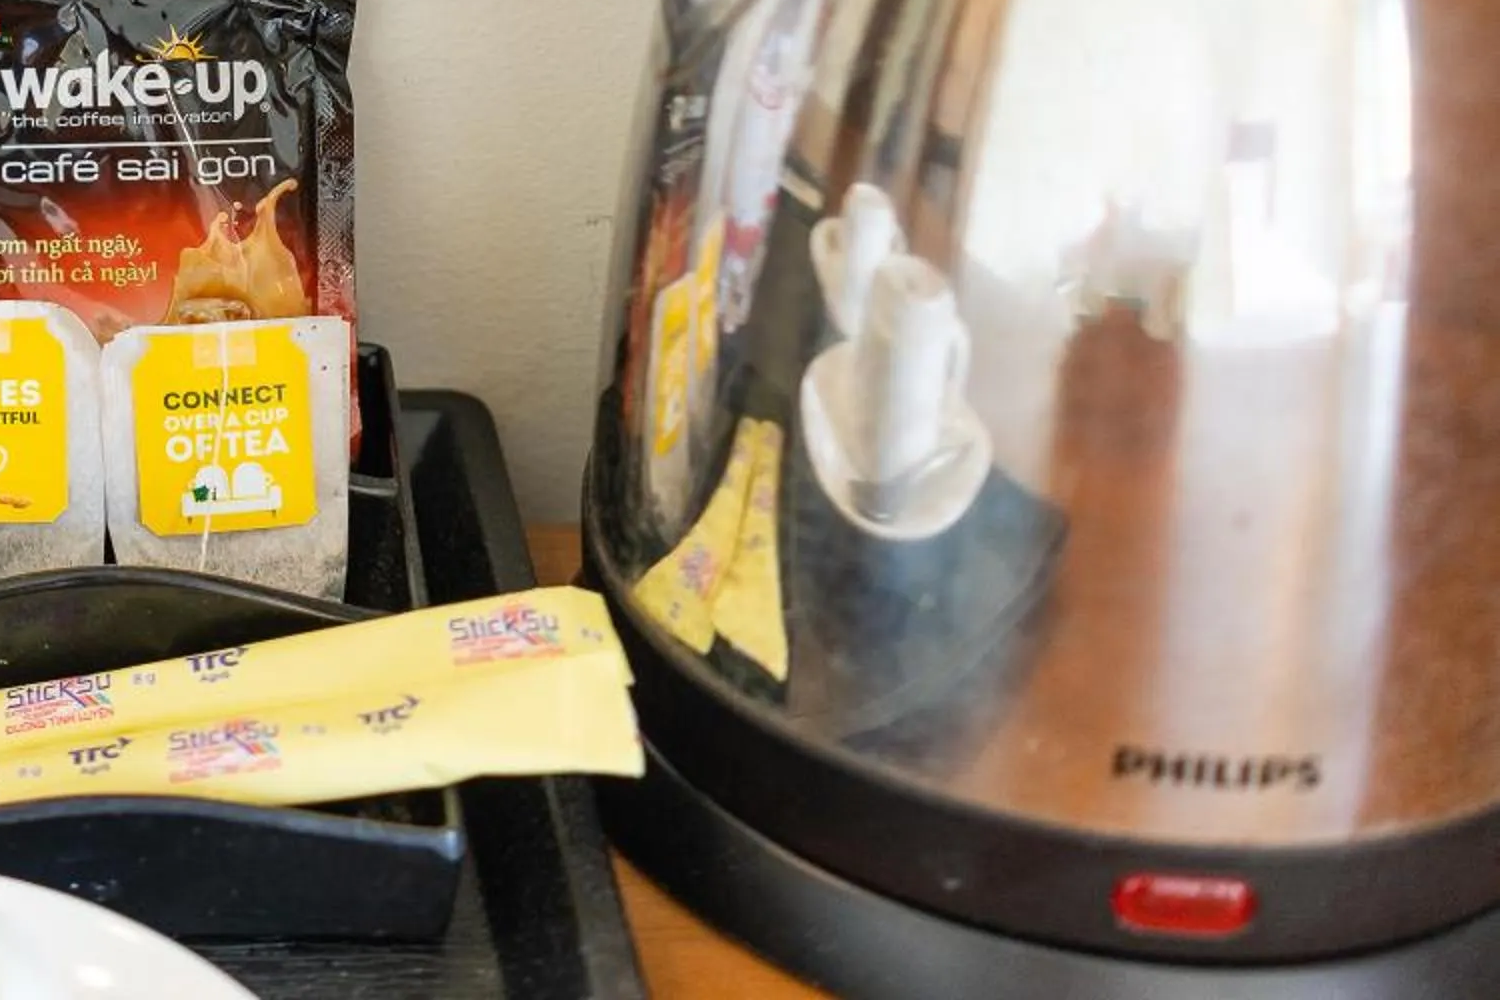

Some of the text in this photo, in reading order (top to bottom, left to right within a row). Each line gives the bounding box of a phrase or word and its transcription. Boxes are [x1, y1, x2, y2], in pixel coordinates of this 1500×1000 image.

[55, 110, 125, 127] coffee
[132, 109, 233, 126] innovator
[1, 147, 276, 185] café sài gòn
[35, 231, 84, 259] ngất
[88, 234, 143, 259] ngây,
[163, 384, 287, 410] CONNECT
[163, 407, 289, 433] OVER A CUP
[165, 427, 290, 463] OF TEA
[187, 651, 239, 672] TTC
[68, 743, 120, 764] TTC
[1112, 745, 1322, 791] PHILIPS
